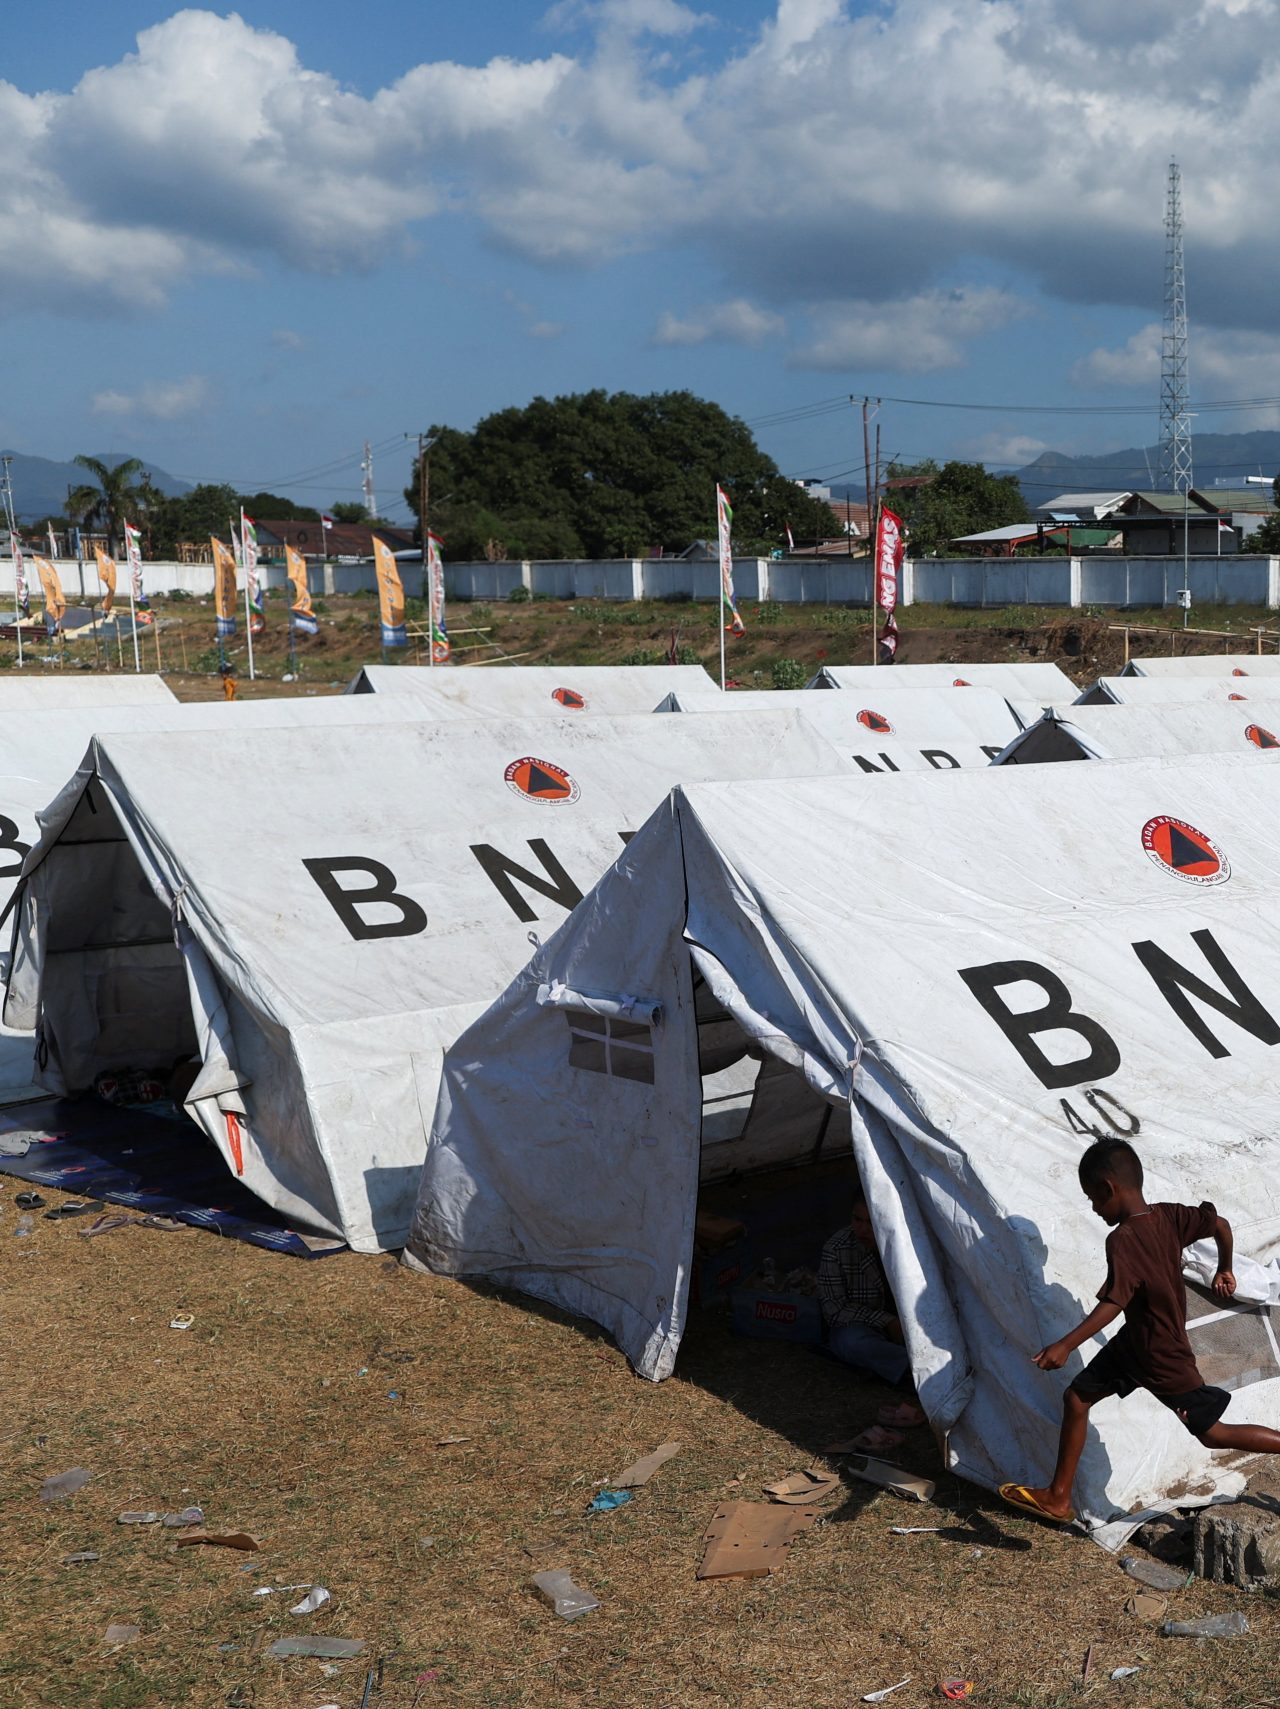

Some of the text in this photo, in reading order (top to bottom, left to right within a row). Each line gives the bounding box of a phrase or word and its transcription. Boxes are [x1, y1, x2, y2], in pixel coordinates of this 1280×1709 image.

[881, 517, 898, 577] EMAS
[881, 578, 896, 611] NG
[523, 758, 565, 776] NASIONAL
[1144, 822, 1157, 848] BADAN
[1158, 817, 1207, 840] NASIONAL
[1212, 845, 1228, 874] BENCANA
[302, 831, 637, 941] BN
[1059, 1088, 1141, 1138] 40
[757, 1303, 796, 1322] Nusra
